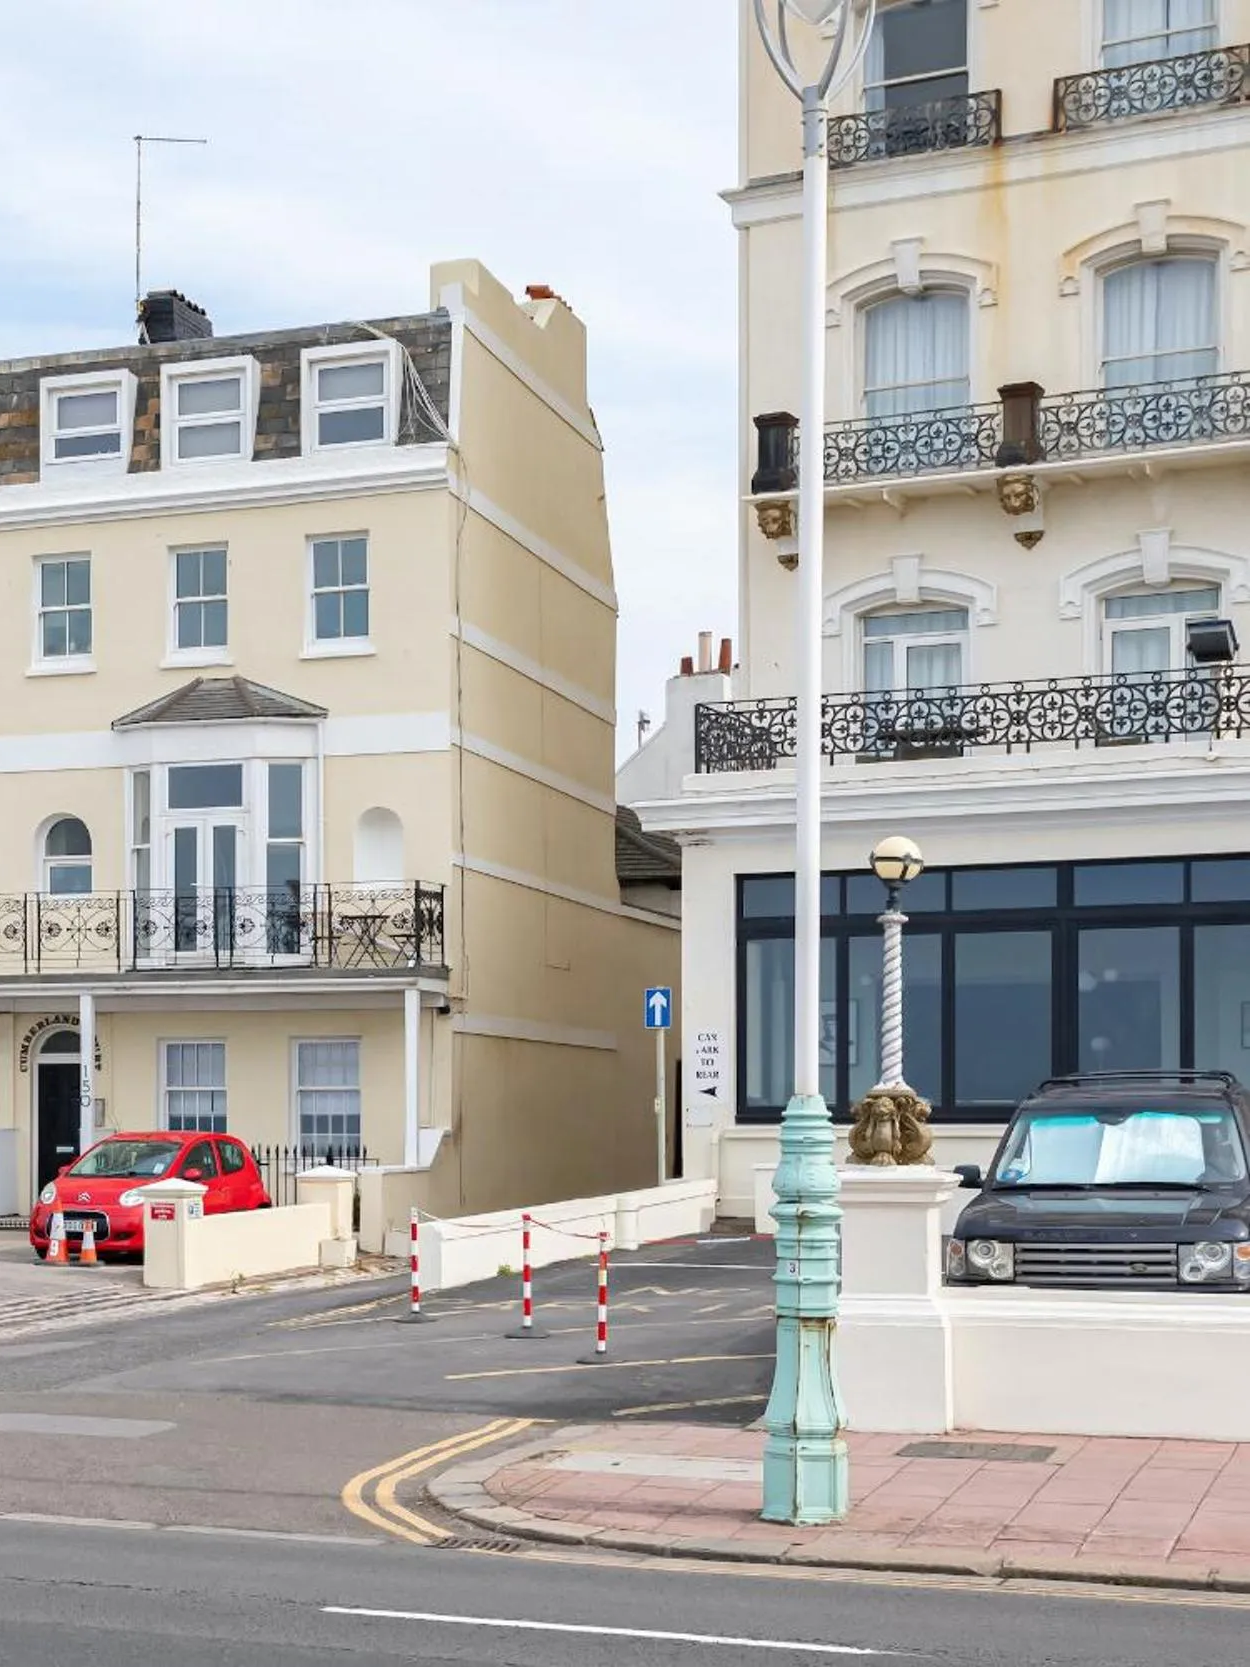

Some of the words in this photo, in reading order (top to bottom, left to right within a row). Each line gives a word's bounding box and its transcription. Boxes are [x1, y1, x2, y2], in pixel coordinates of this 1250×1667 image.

[697, 1033, 718, 1041] CAR
[19, 1014, 80, 1073] CUMBERLAND
[696, 1046, 719, 1054] ARK
[700, 1058, 714, 1066] TO
[696, 1071, 719, 1079] REAR
[80, 1064, 91, 1107] 150
